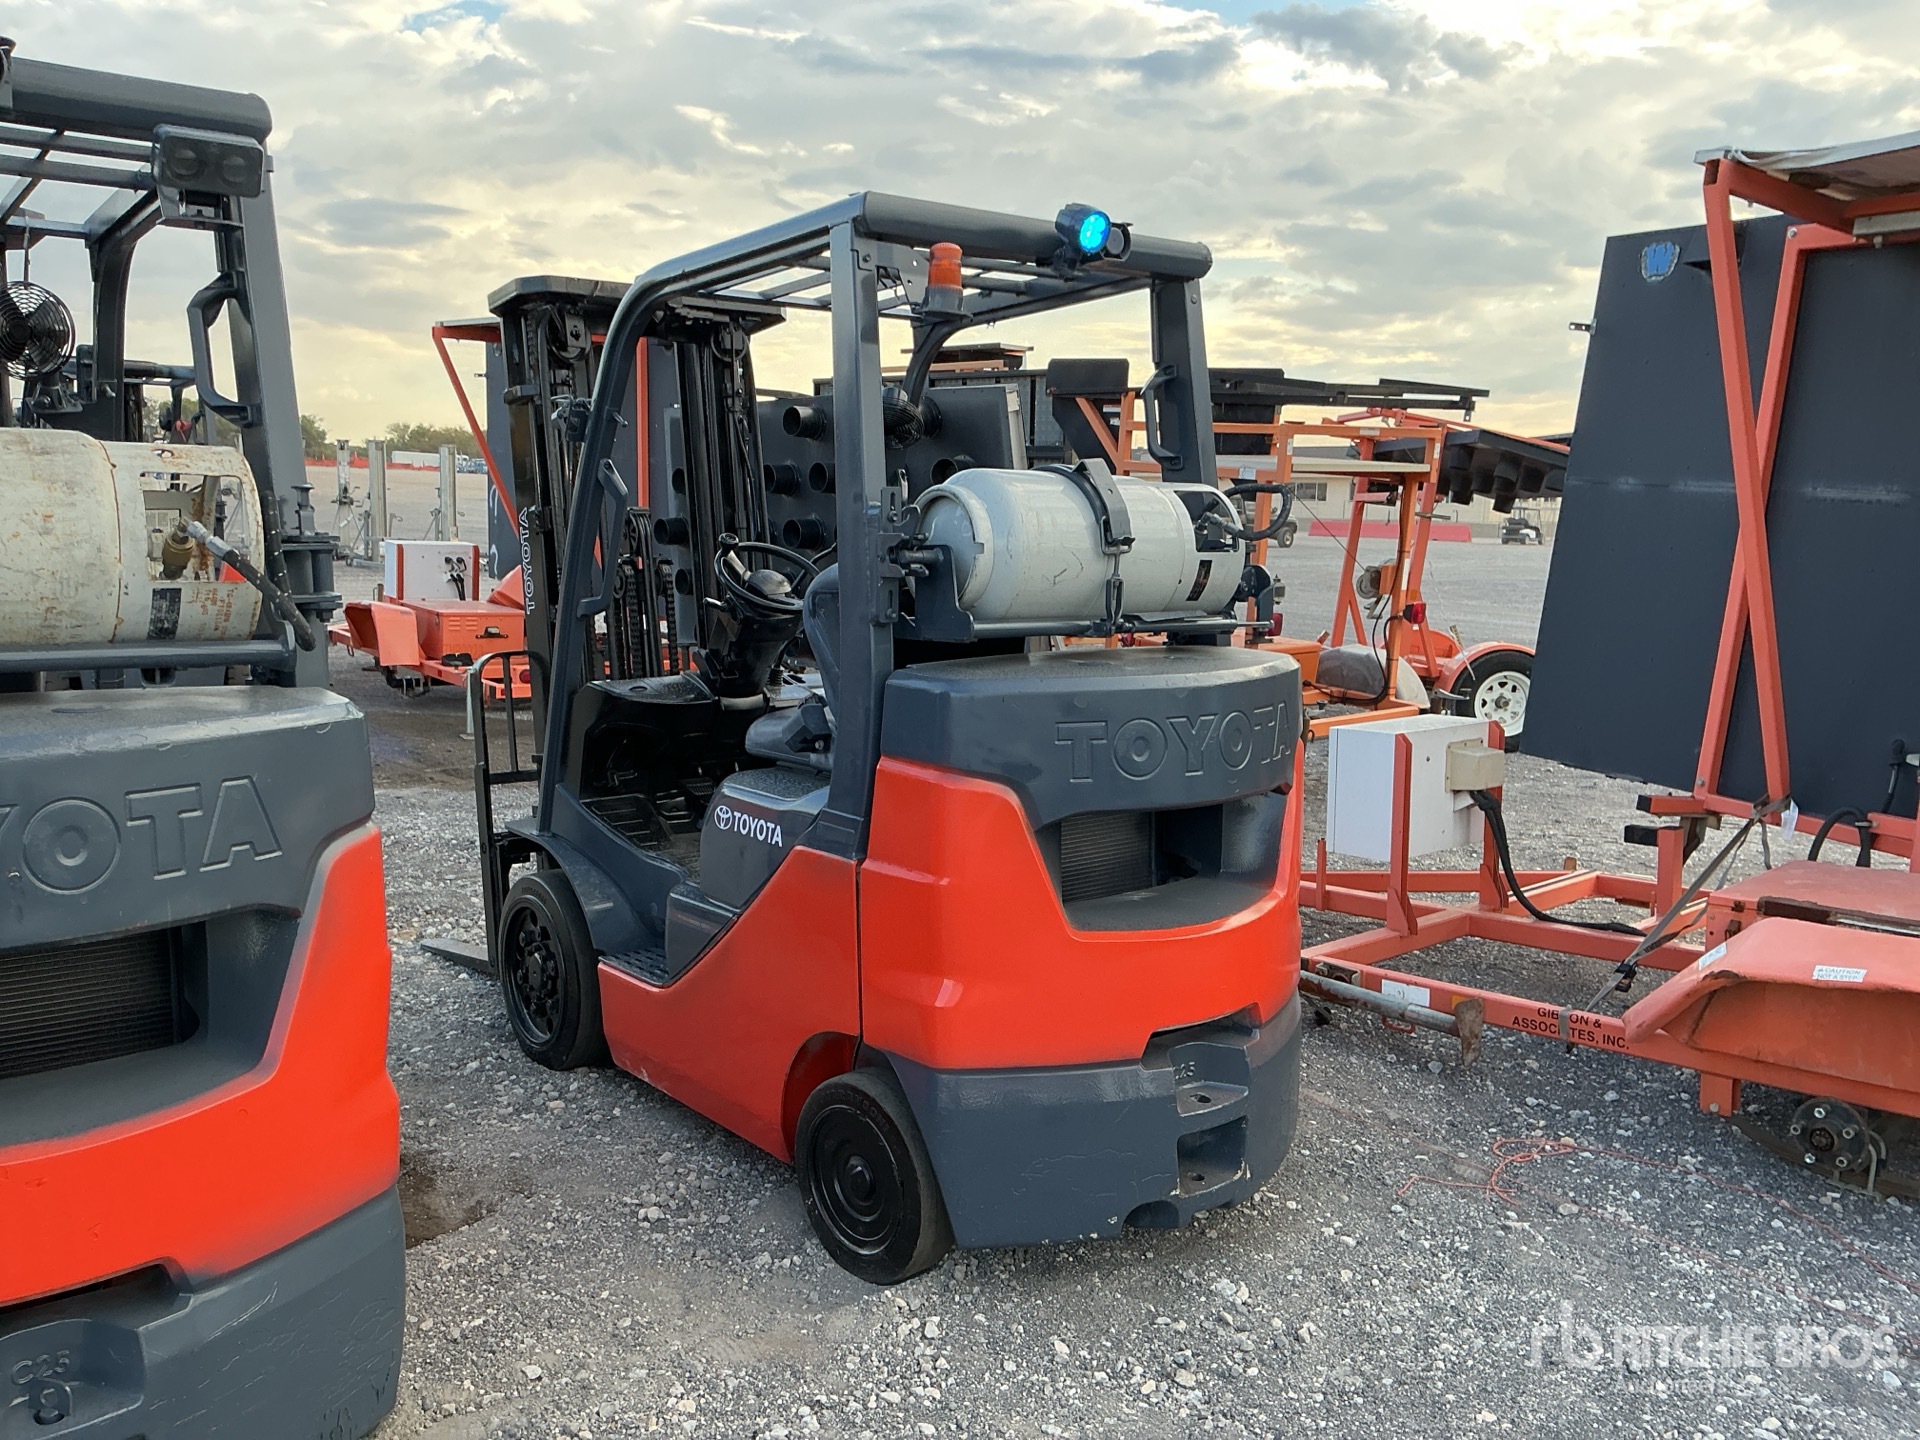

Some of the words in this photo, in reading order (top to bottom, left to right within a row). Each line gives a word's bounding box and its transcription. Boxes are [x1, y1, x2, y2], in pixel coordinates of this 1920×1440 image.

[519, 507, 535, 615] TOYOTA
[1054, 700, 1291, 783] TOYOTA
[0, 774, 284, 896] OTA
[733, 811, 783, 848] TOYOTA
[1512, 1016, 1599, 1045] ASSOCITES,
[1602, 1033, 1630, 1050] INC.
[1537, 1007, 1589, 1026] GIBON
[1593, 1019, 1602, 1029] &
[11, 1349, 70, 1385] C25
